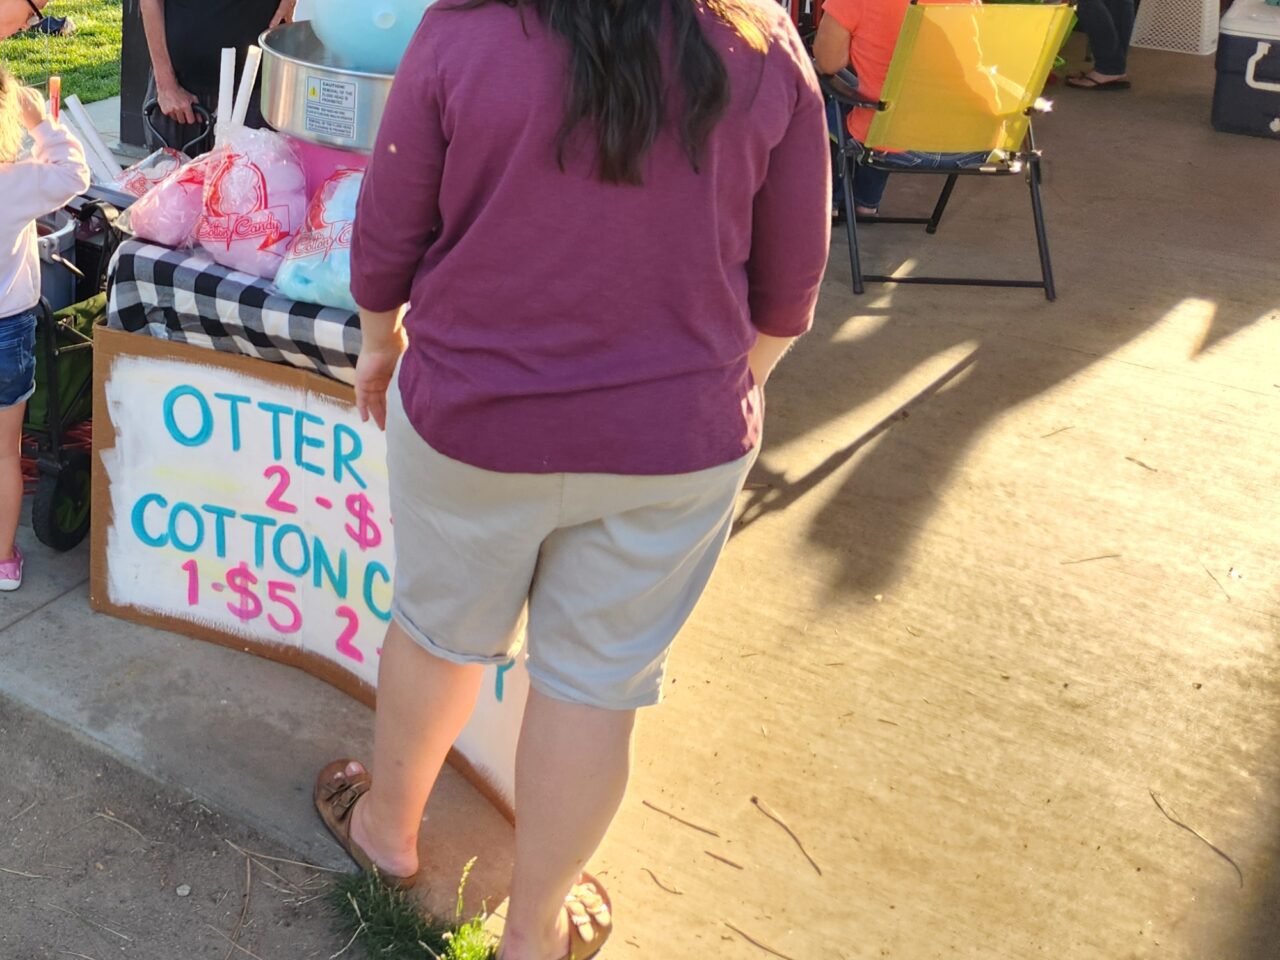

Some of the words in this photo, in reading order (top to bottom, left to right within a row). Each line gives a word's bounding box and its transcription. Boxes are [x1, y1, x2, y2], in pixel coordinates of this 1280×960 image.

[198, 216, 228, 238] Cotton
[233, 212, 282, 239] Candy
[163, 384, 367, 490] OTTER
[131, 493, 348, 600] COTTON
